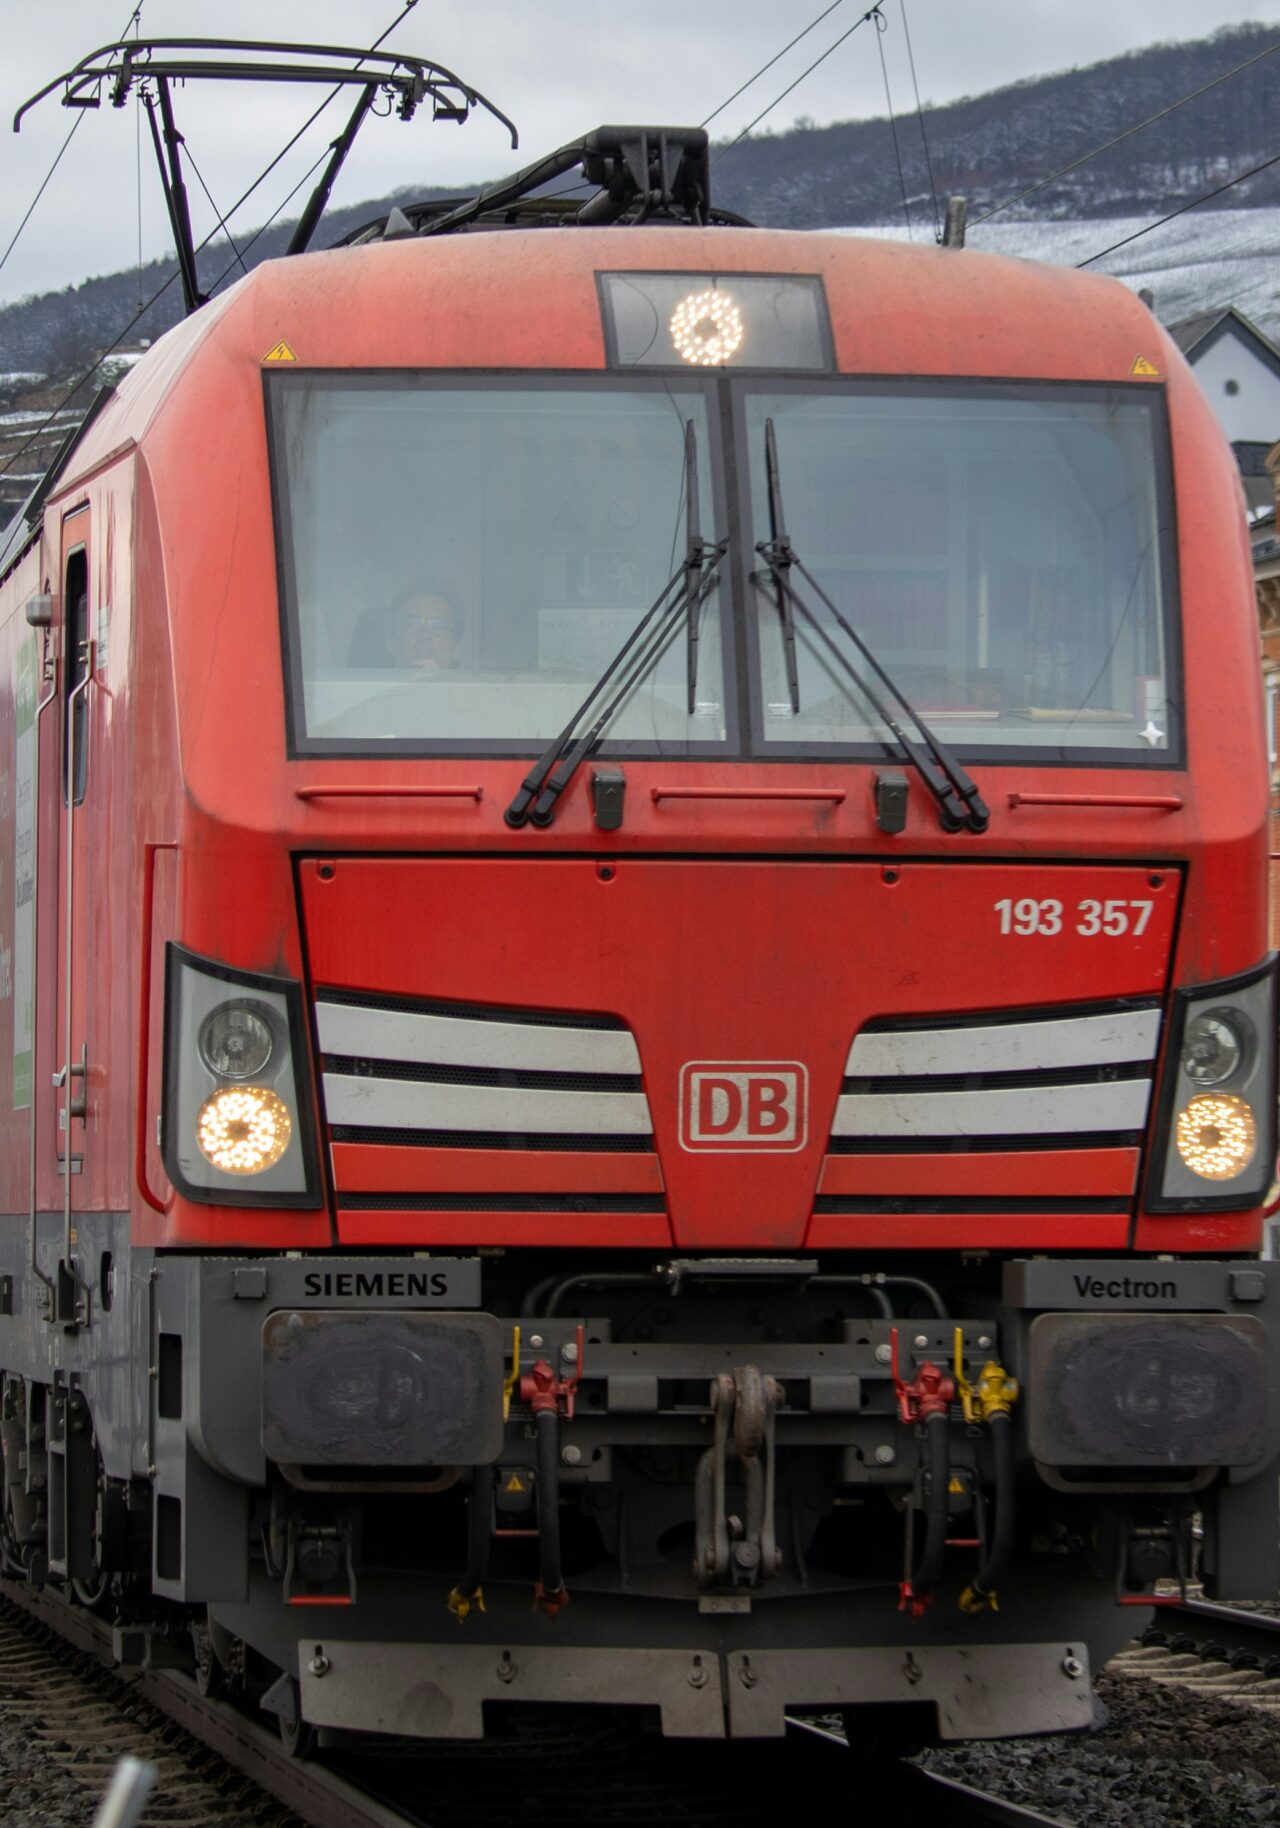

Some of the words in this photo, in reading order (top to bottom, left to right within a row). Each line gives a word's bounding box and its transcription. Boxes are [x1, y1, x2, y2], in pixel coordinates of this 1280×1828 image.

[994, 899, 1063, 935] 193
[1076, 899, 1154, 936] 357
[698, 1079, 789, 1135] DB
[304, 1273, 448, 1297] SIEMENS
[1073, 1275, 1177, 1298] Vectron
